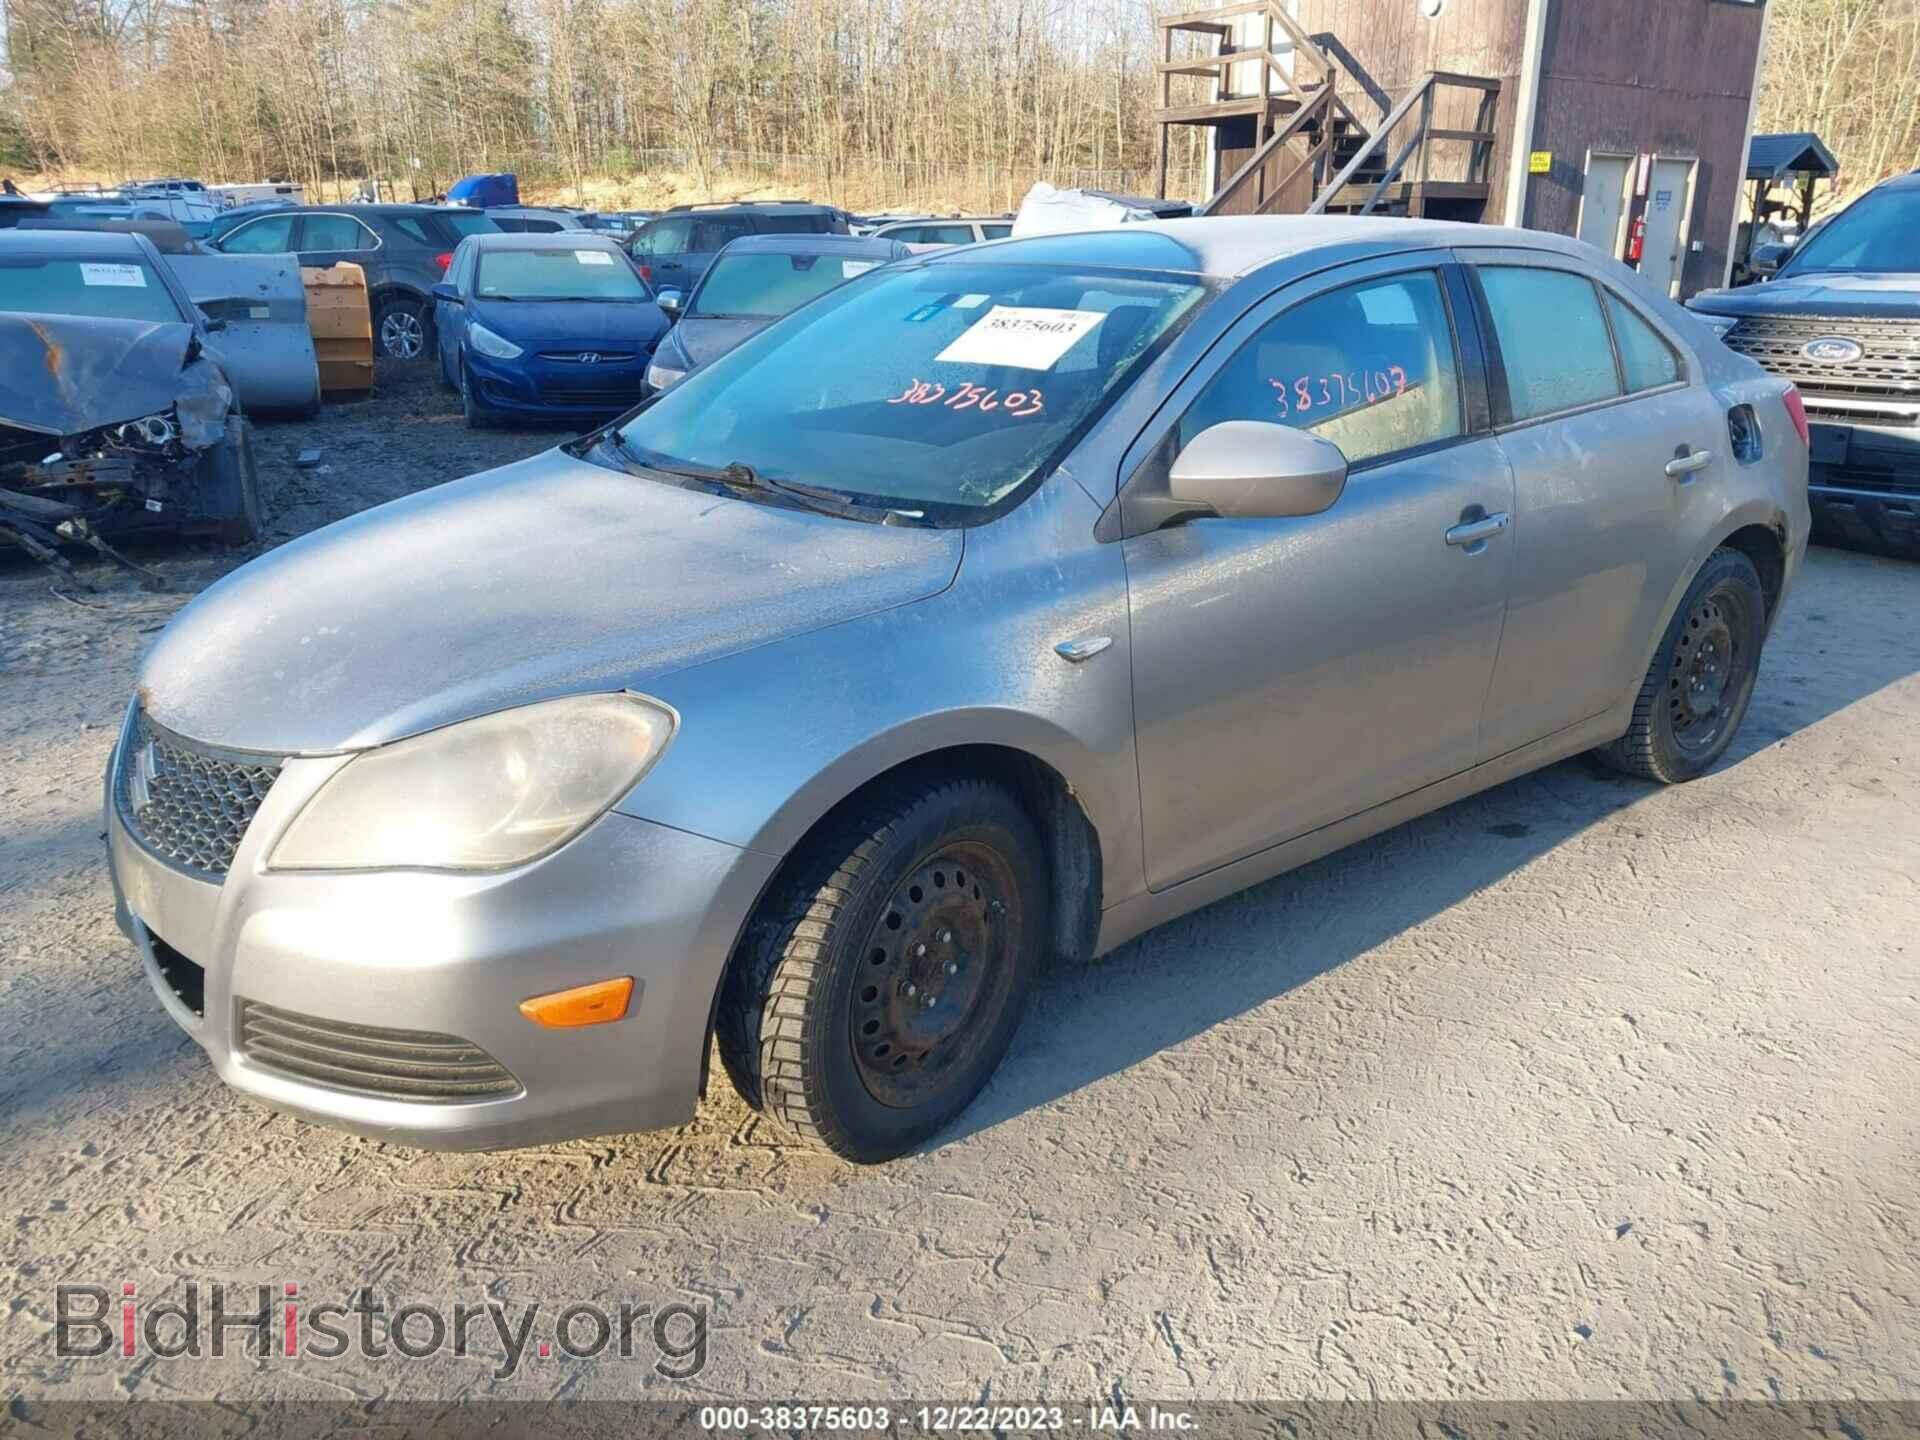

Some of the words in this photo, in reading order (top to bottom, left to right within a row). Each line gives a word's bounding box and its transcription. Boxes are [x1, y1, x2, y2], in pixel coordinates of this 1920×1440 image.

[985, 318, 1077, 334] 38375603
[887, 378, 1044, 416] 38375603
[1268, 365, 1407, 418] 38375603
